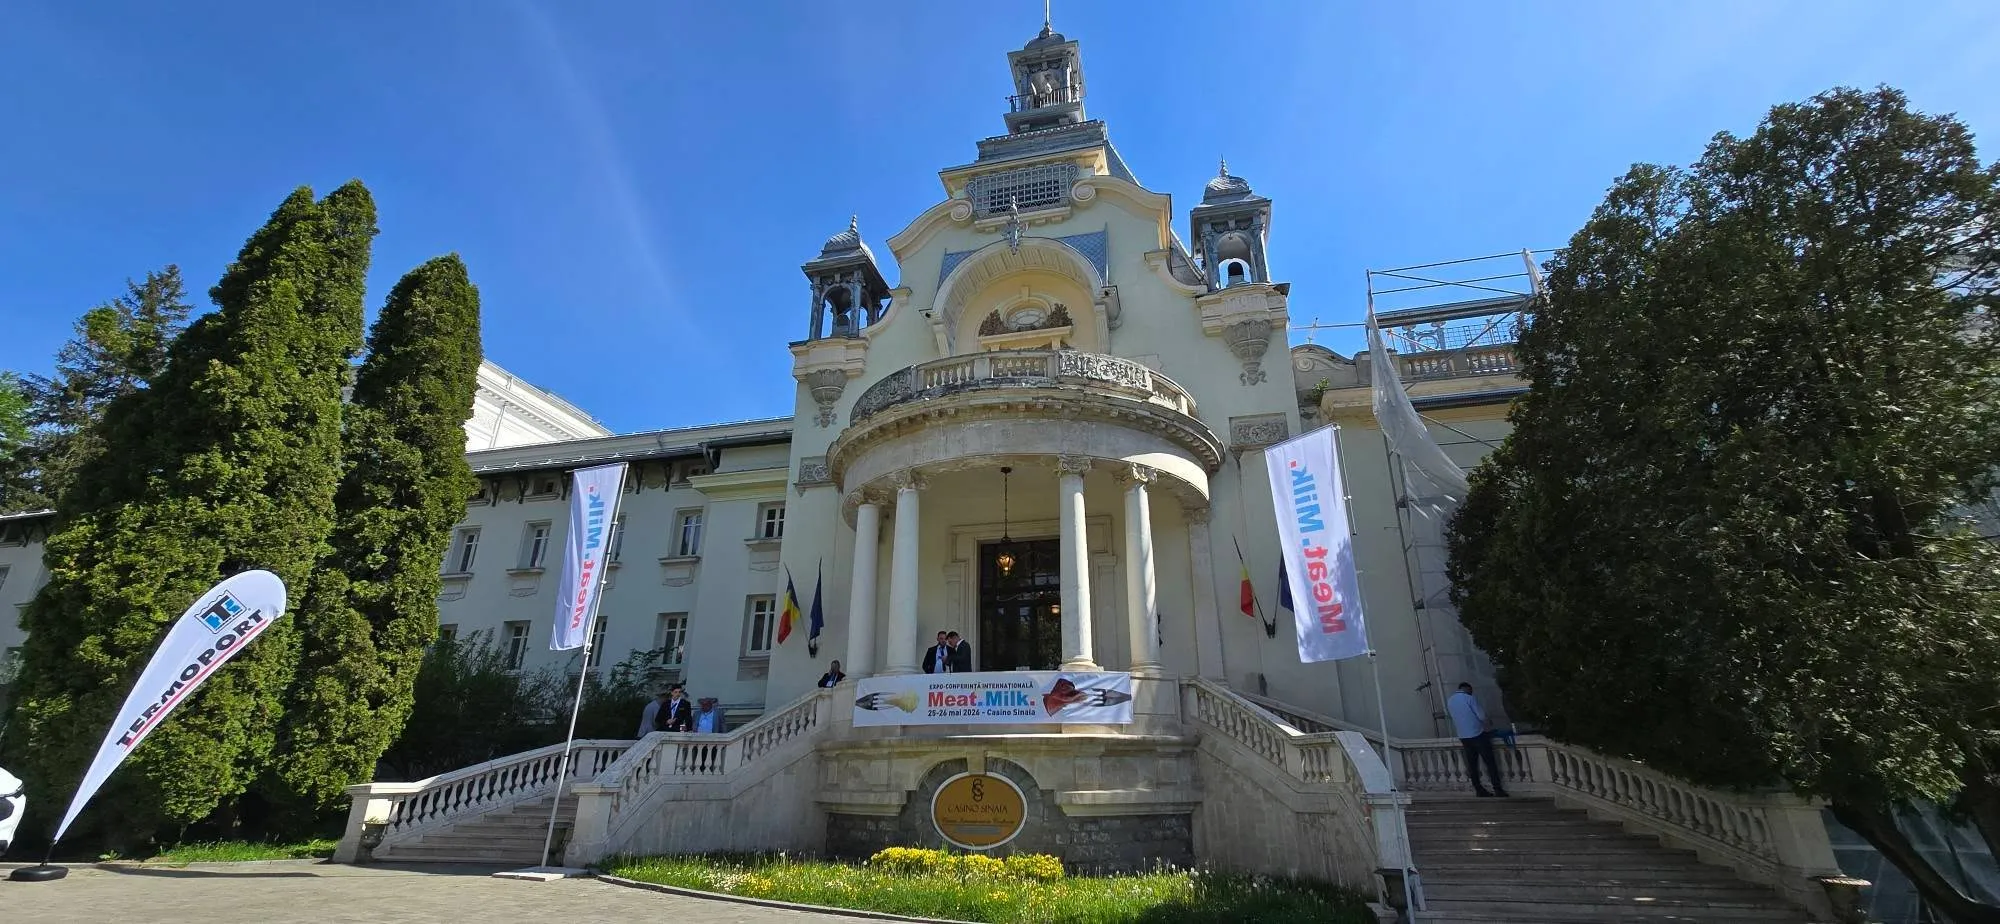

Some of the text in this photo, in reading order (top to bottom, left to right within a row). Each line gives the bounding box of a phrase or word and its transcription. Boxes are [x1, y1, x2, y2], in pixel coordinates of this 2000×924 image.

[116, 609, 265, 747] TERMOPORT
[928, 709, 947, 717] 25-26
[947, 804, 1008, 813] CASINO SINAIA
